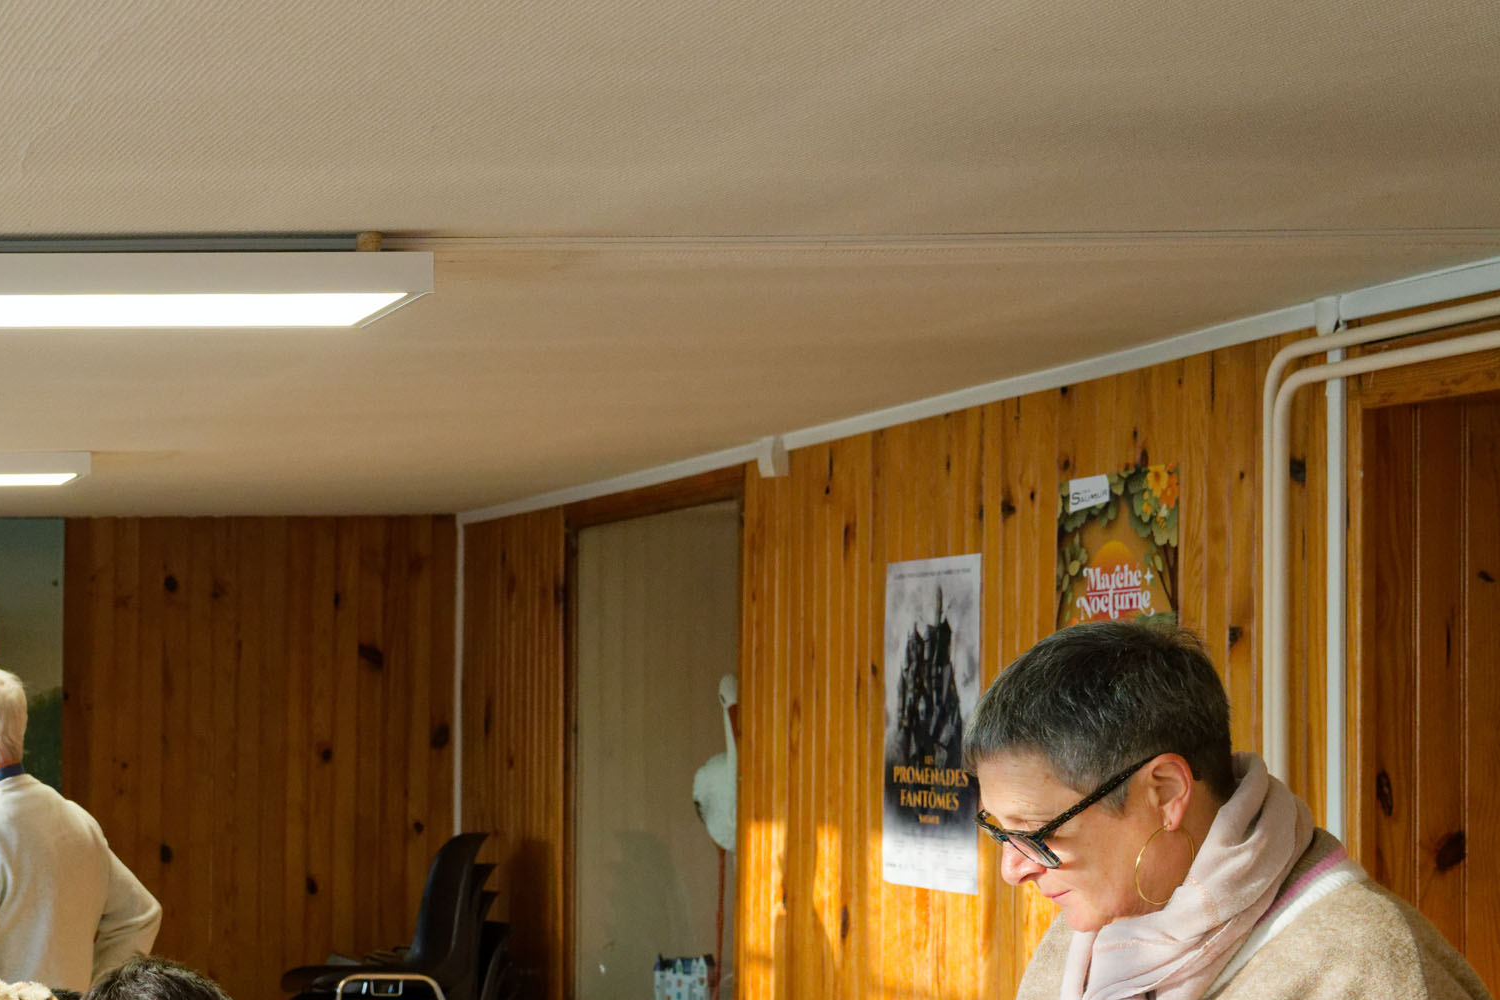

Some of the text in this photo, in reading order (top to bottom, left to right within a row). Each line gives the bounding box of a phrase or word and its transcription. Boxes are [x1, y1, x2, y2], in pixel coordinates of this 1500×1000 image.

[1083, 563, 1142, 592] Marché
[1076, 589, 1155, 620] Nocturne
[893, 765, 969, 787] PROMENADES
[900, 787, 959, 811] FANTÔMES
